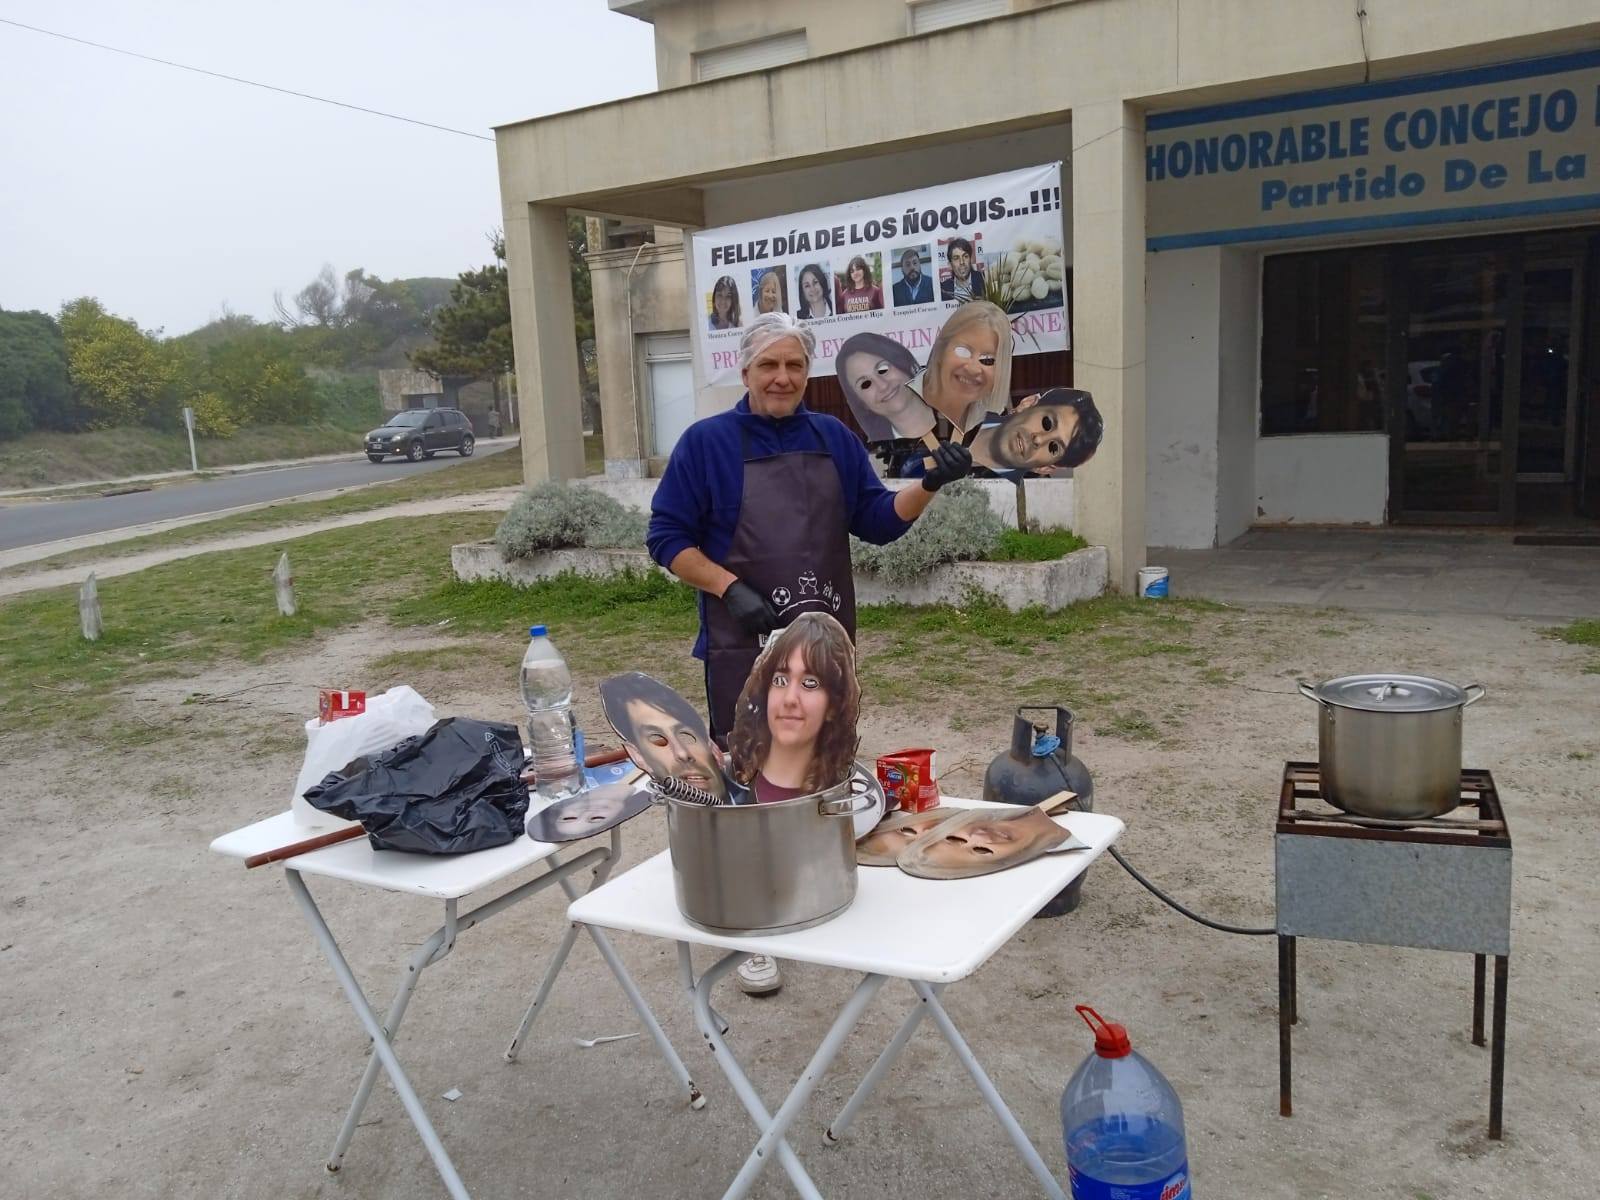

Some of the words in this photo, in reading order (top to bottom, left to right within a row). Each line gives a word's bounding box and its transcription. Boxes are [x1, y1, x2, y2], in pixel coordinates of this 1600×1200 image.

[1146, 117, 1370, 182] HONORABLE
[1384, 88, 1578, 152] CONCEJO
[1261, 165, 1426, 211] Partido
[1444, 158, 1508, 193] De
[1528, 150, 1586, 184] La
[711, 238, 768, 266] FELIZ
[773, 229, 812, 257] DÍA
[815, 226, 845, 250] DE
[850, 215, 897, 245] LOS
